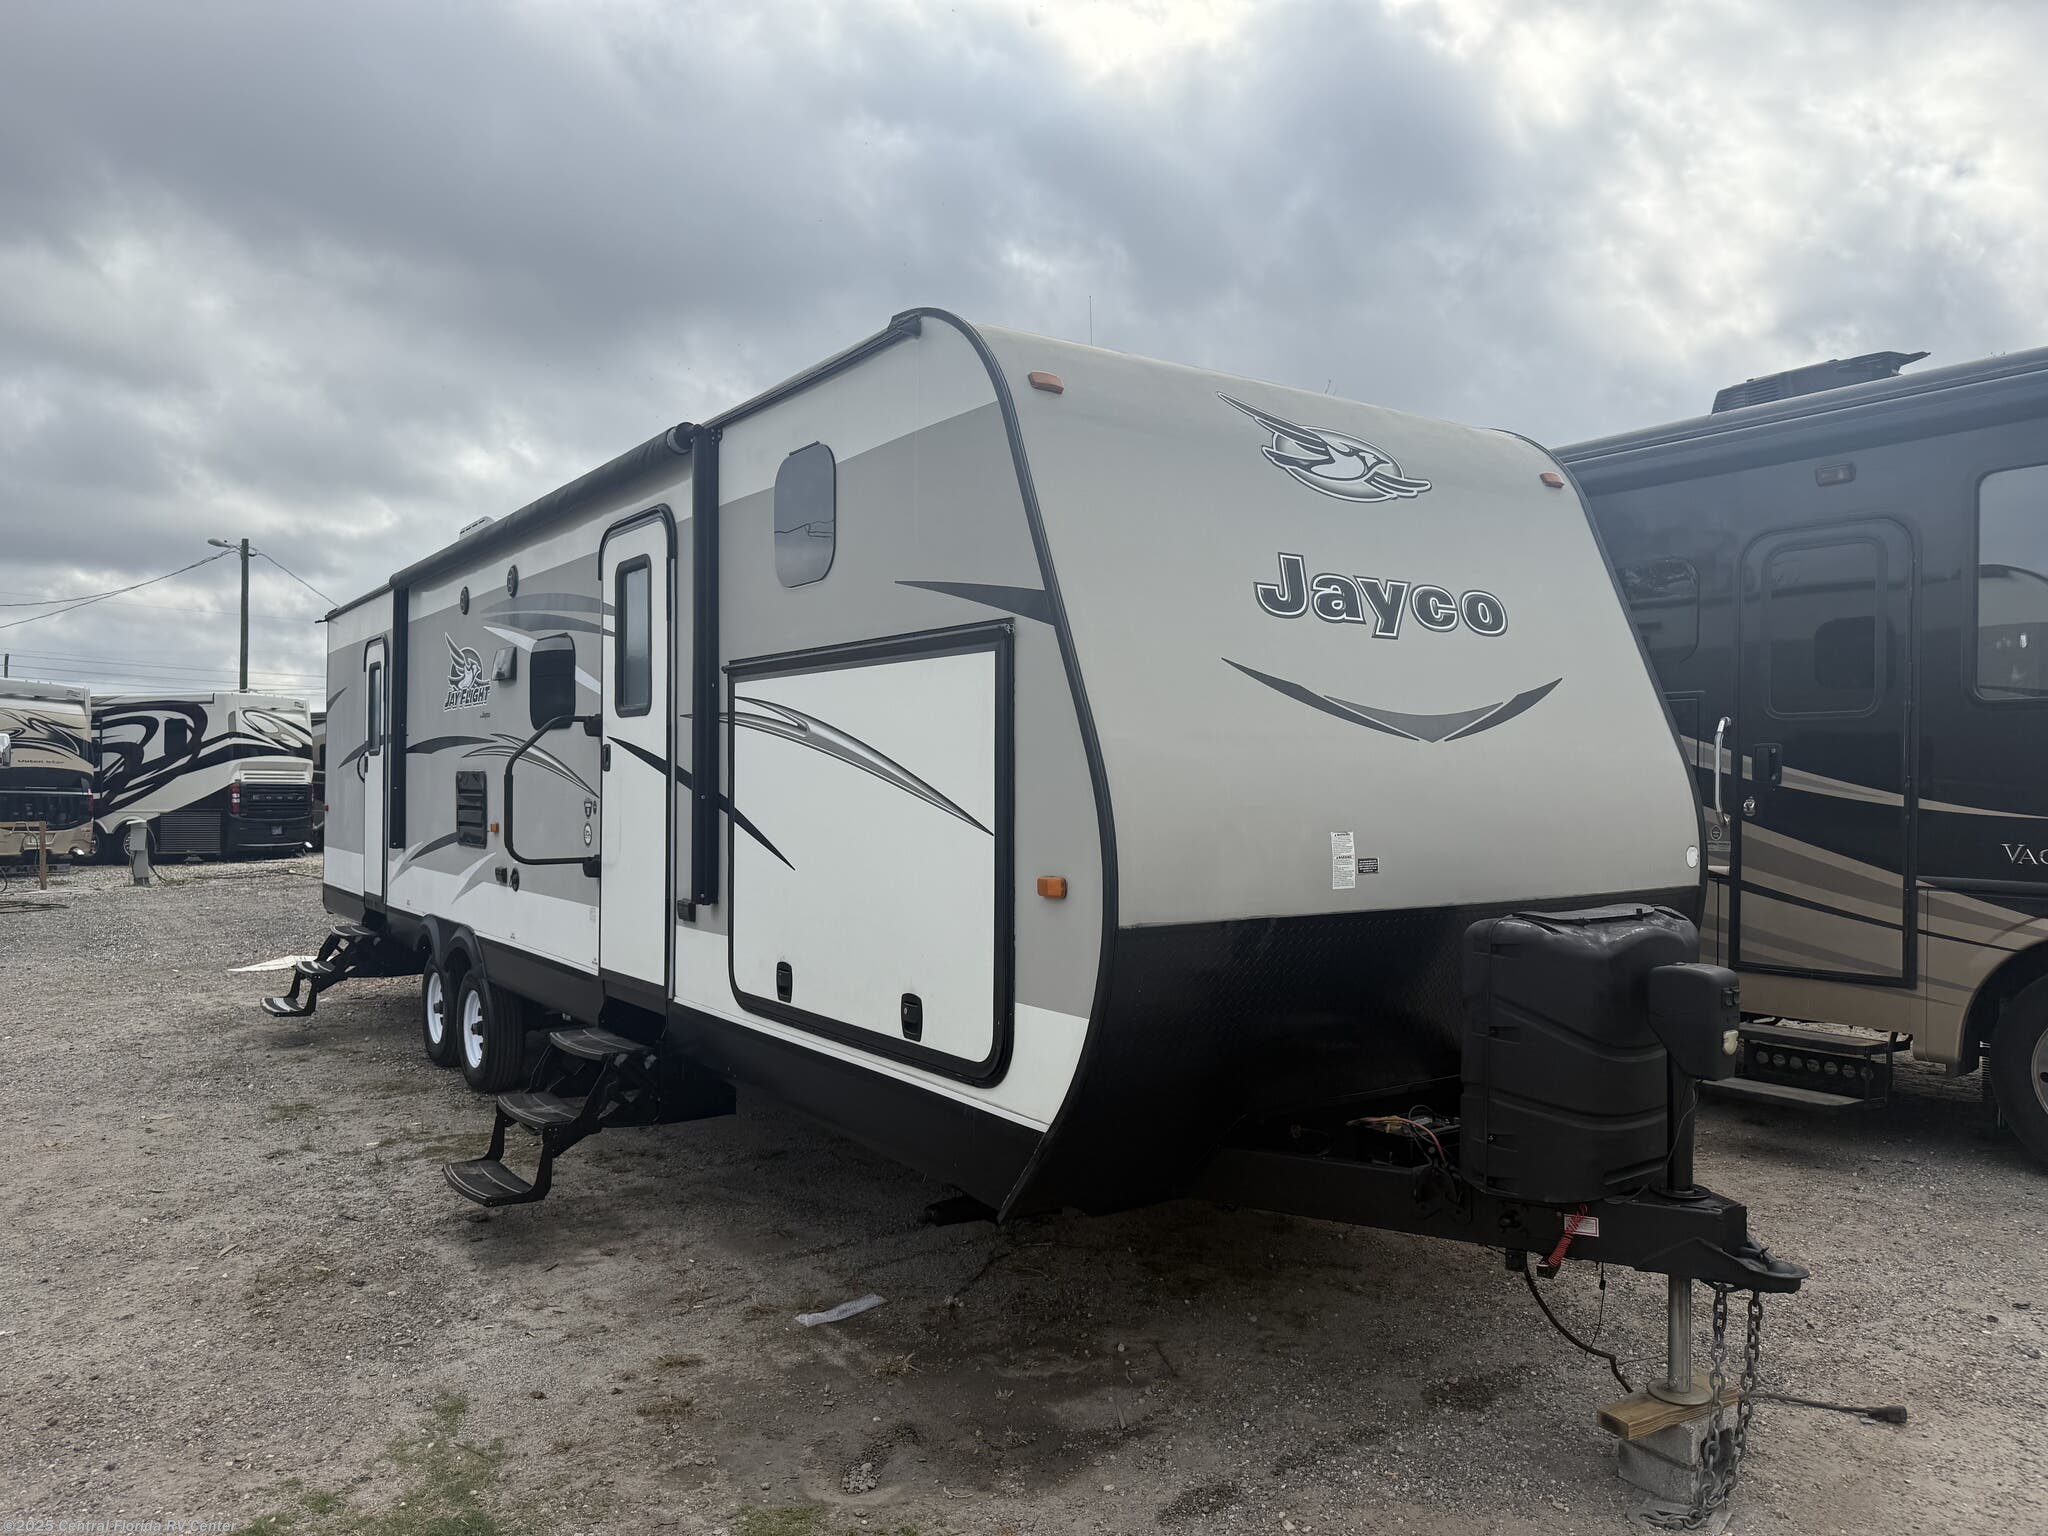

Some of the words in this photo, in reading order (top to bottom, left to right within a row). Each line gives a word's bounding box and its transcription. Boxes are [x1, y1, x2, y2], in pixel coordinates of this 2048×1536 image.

[1254, 552, 1508, 640] Jayco
[444, 690, 461, 711] JAY
[459, 685, 491, 708] FLIGHT
